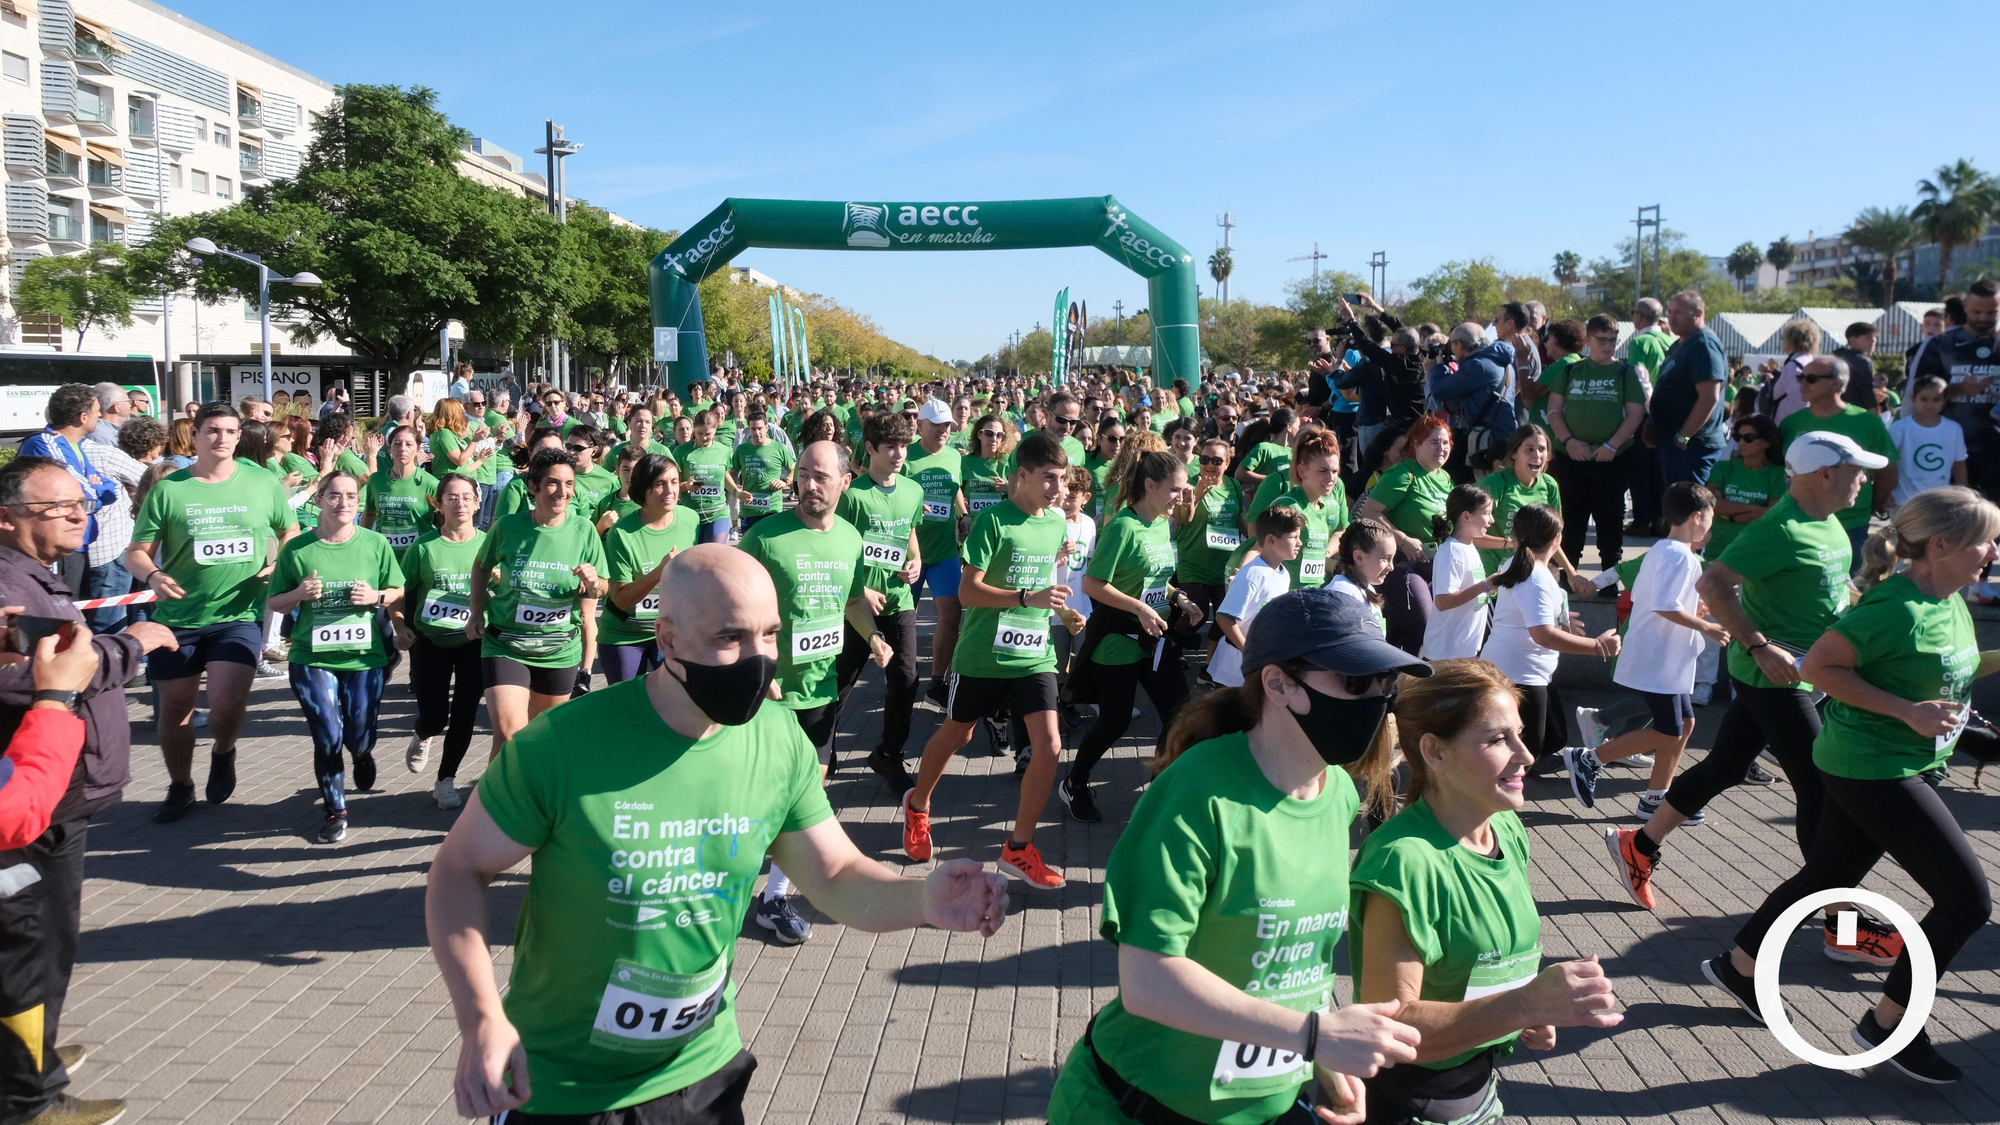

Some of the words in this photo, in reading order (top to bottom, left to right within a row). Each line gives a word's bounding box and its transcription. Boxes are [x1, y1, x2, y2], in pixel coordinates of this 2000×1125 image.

[898, 206, 979, 226] aecc
[900, 232, 925, 244] en
[927, 227, 998, 244] marcha
[686, 220, 735, 264] aecc
[1120, 231, 1176, 268] aecc
[660, 332, 672, 346] P
[1950, 365, 1971, 375] NIKE
[241, 372, 311, 384] PISANO
[1589, 379, 1614, 387] aecc
[1738, 490, 1768, 500] marcha
[186, 507, 201, 516] En
[205, 505, 247, 514] marcha
[188, 516, 223, 526] contra
[883, 517, 910, 527] marcha
[1211, 536, 1236, 545] 0604
[203, 542, 248, 556] 0313
[865, 546, 900, 561] 0618
[1011, 553, 1024, 562] En
[1027, 554, 1057, 564] march
[1818, 551, 1831, 561] En
[514, 558, 526, 566] En
[529, 560, 569, 571] marcha
[796, 560, 811, 569] En
[814, 560, 848, 570] marcha
[1009, 564, 1039, 573] contra
[511, 569, 544, 579] contra
[798, 571, 830, 581] contra
[1006, 575, 1016, 583] el
[1019, 575, 1048, 585] cáncer
[520, 580, 558, 590] cáncer
[1820, 576, 1830, 586] el
[797, 583, 806, 593] el
[810, 582, 842, 593] cáncer
[322, 590, 343, 598] ntra
[323, 598, 353, 608] cánce
[430, 604, 470, 621] 0120
[523, 610, 566, 622] 0226
[320, 628, 365, 641] 0119
[1002, 631, 1042, 647] 0034
[800, 631, 840, 652] 0225
[1941, 654, 1956, 666] En
[1943, 665, 1973, 681] contra
[614, 801, 654, 810] Córdoba
[613, 815, 649, 839] En
[660, 812, 750, 839] marcha
[611, 844, 695, 869] contra
[608, 873, 633, 895] el
[642, 871, 729, 896] cáncer
[1259, 898, 1295, 908] Córdoba
[1256, 914, 1290, 939] En
[1294, 905, 1348, 935] march
[619, 964, 650, 978] Córdoba
[662, 974, 690, 984] Marcha
[1264, 962, 1329, 990] cáncer
[615, 992, 717, 1033] 0155
